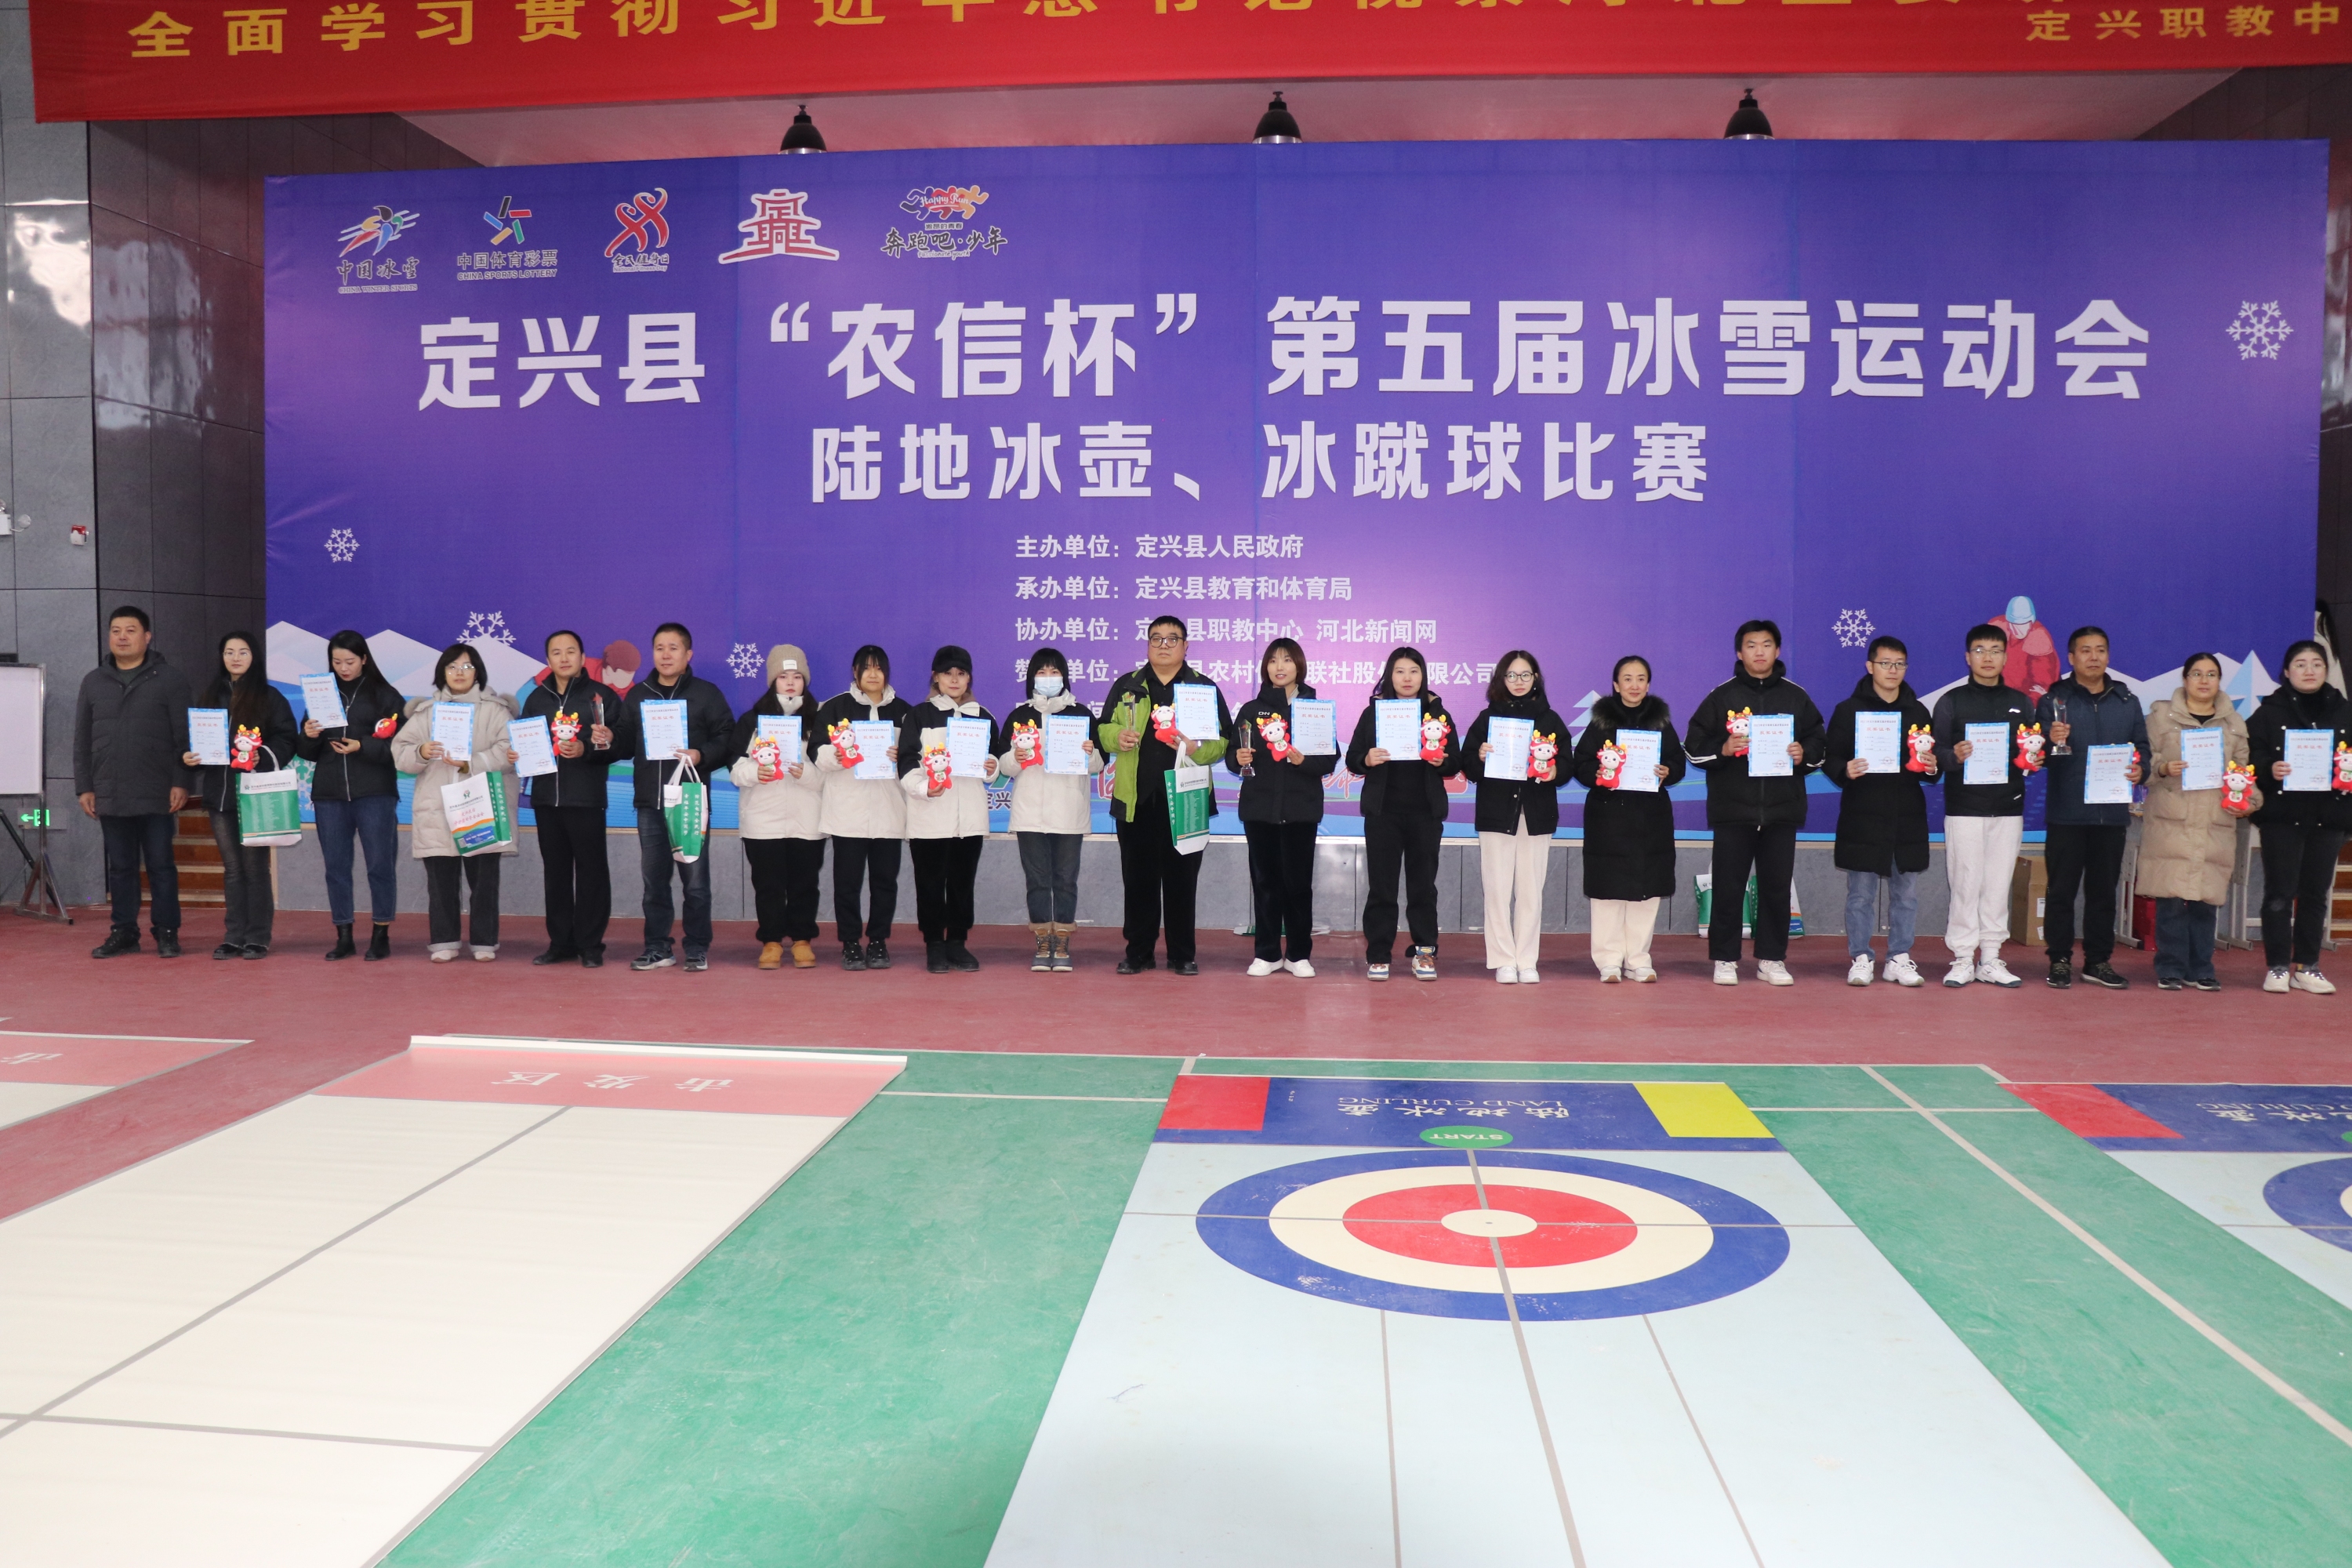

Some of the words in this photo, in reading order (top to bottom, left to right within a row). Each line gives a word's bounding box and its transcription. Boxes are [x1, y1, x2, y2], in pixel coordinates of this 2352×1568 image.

[2026, 2, 2339, 41] 定兴职教中
[920, 195, 949, 207] Happy
[950, 193, 969, 204] Run
[457, 250, 557, 270] 中国体育彩票
[612, 252, 670, 267] 全民健身日
[337, 257, 419, 285] 中国冰雪
[458, 272, 483, 281] CHINA
[485, 270, 517, 279] SPORTS
[519, 269, 557, 278] LOTTERY
[1015, 616, 1304, 641] 协办单位：定县职教中心
[1316, 619, 1437, 644] 河北新闻网
[491, 1072, 735, 1092] 击发区
[1338, 1097, 1475, 1106] CURLING
[1483, 1099, 1565, 1108] LAND
[1338, 1104, 1569, 1120] 陆地冰壶
